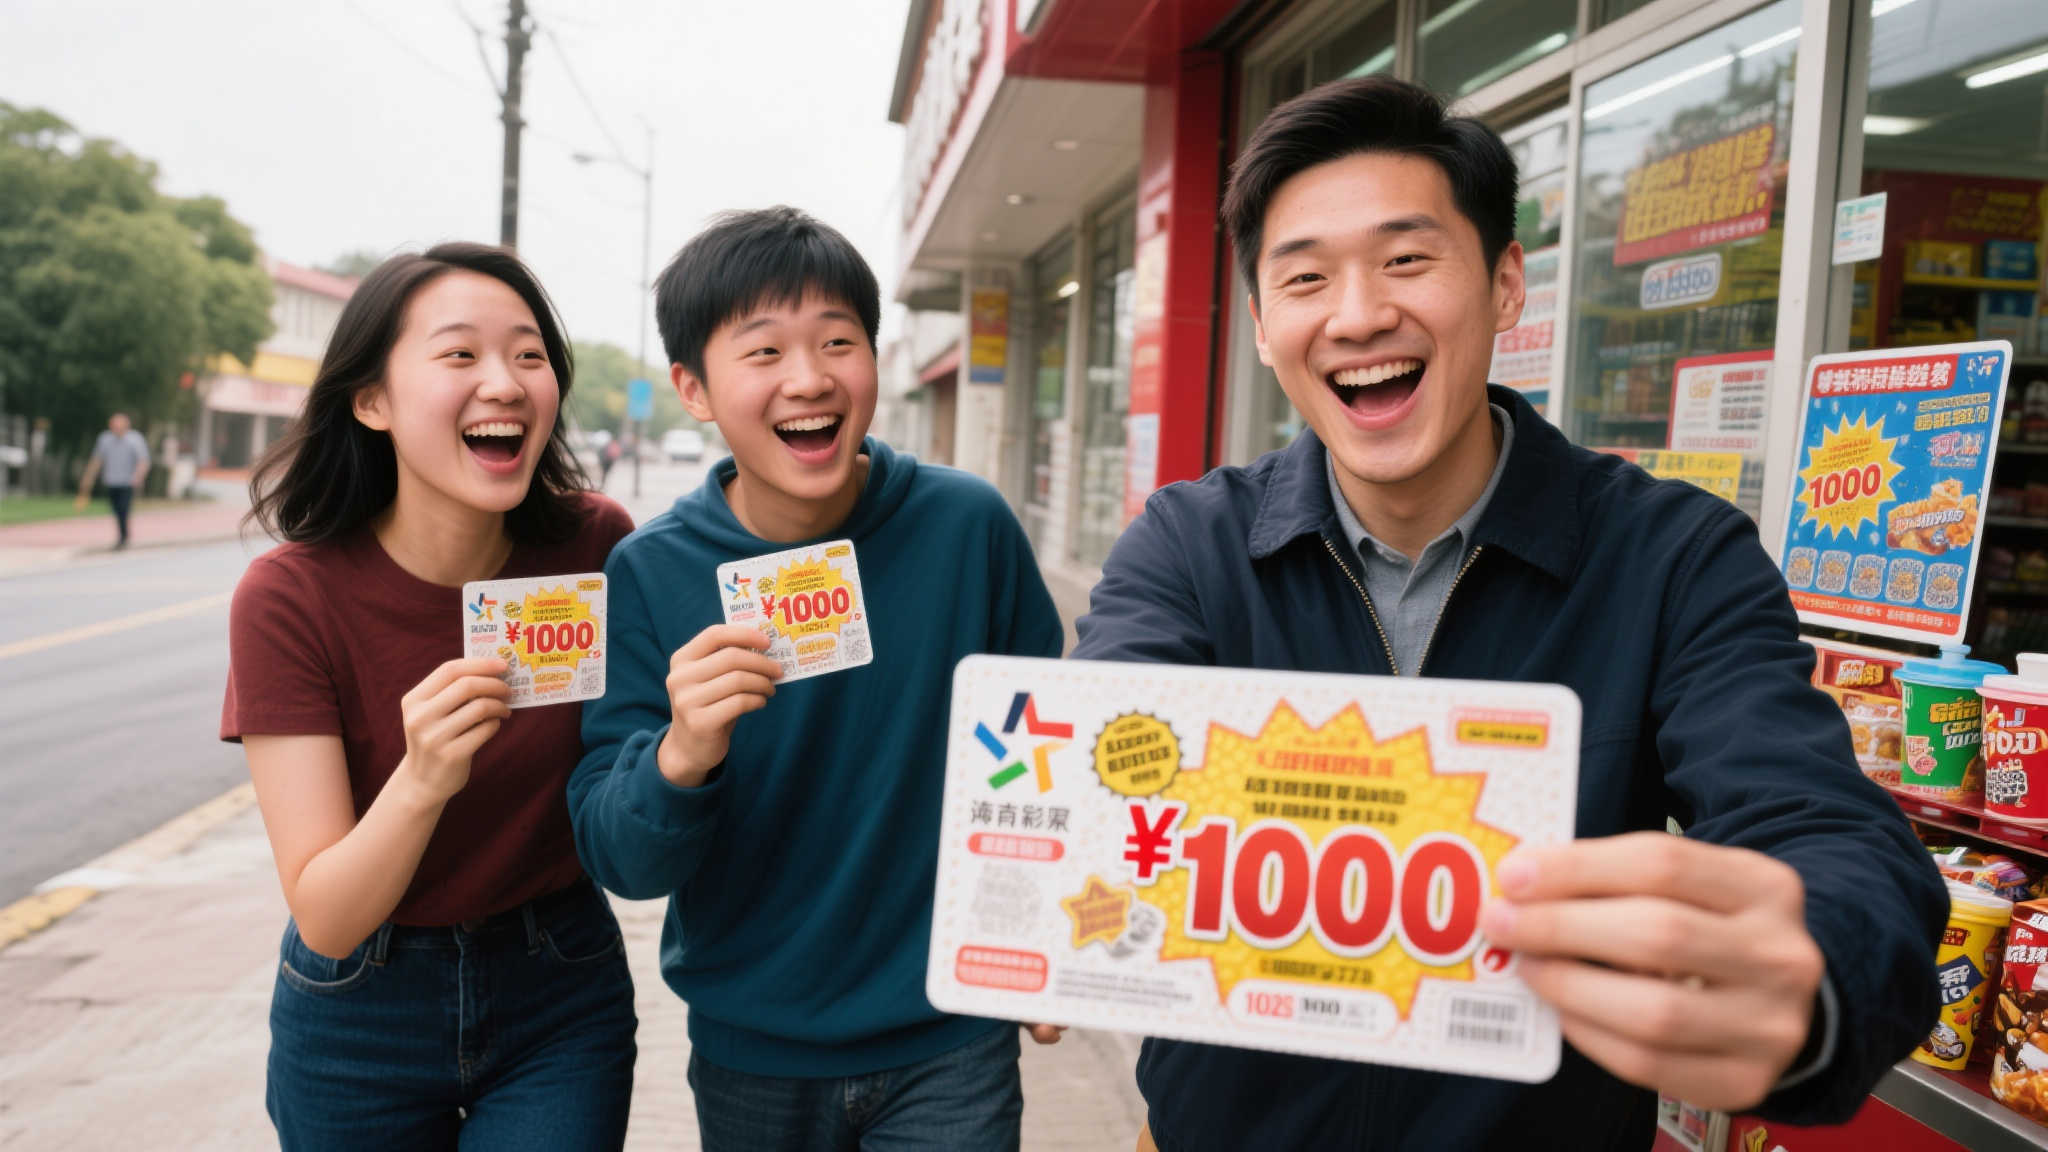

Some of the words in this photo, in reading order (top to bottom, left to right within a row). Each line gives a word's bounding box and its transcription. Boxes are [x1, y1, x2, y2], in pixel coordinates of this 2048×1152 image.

[1809, 464, 1881, 509] 1000
[760, 587, 850, 625] ¥1000
[505, 621, 594, 654] ¥1000
[1123, 804, 1482, 956] ¥1000
